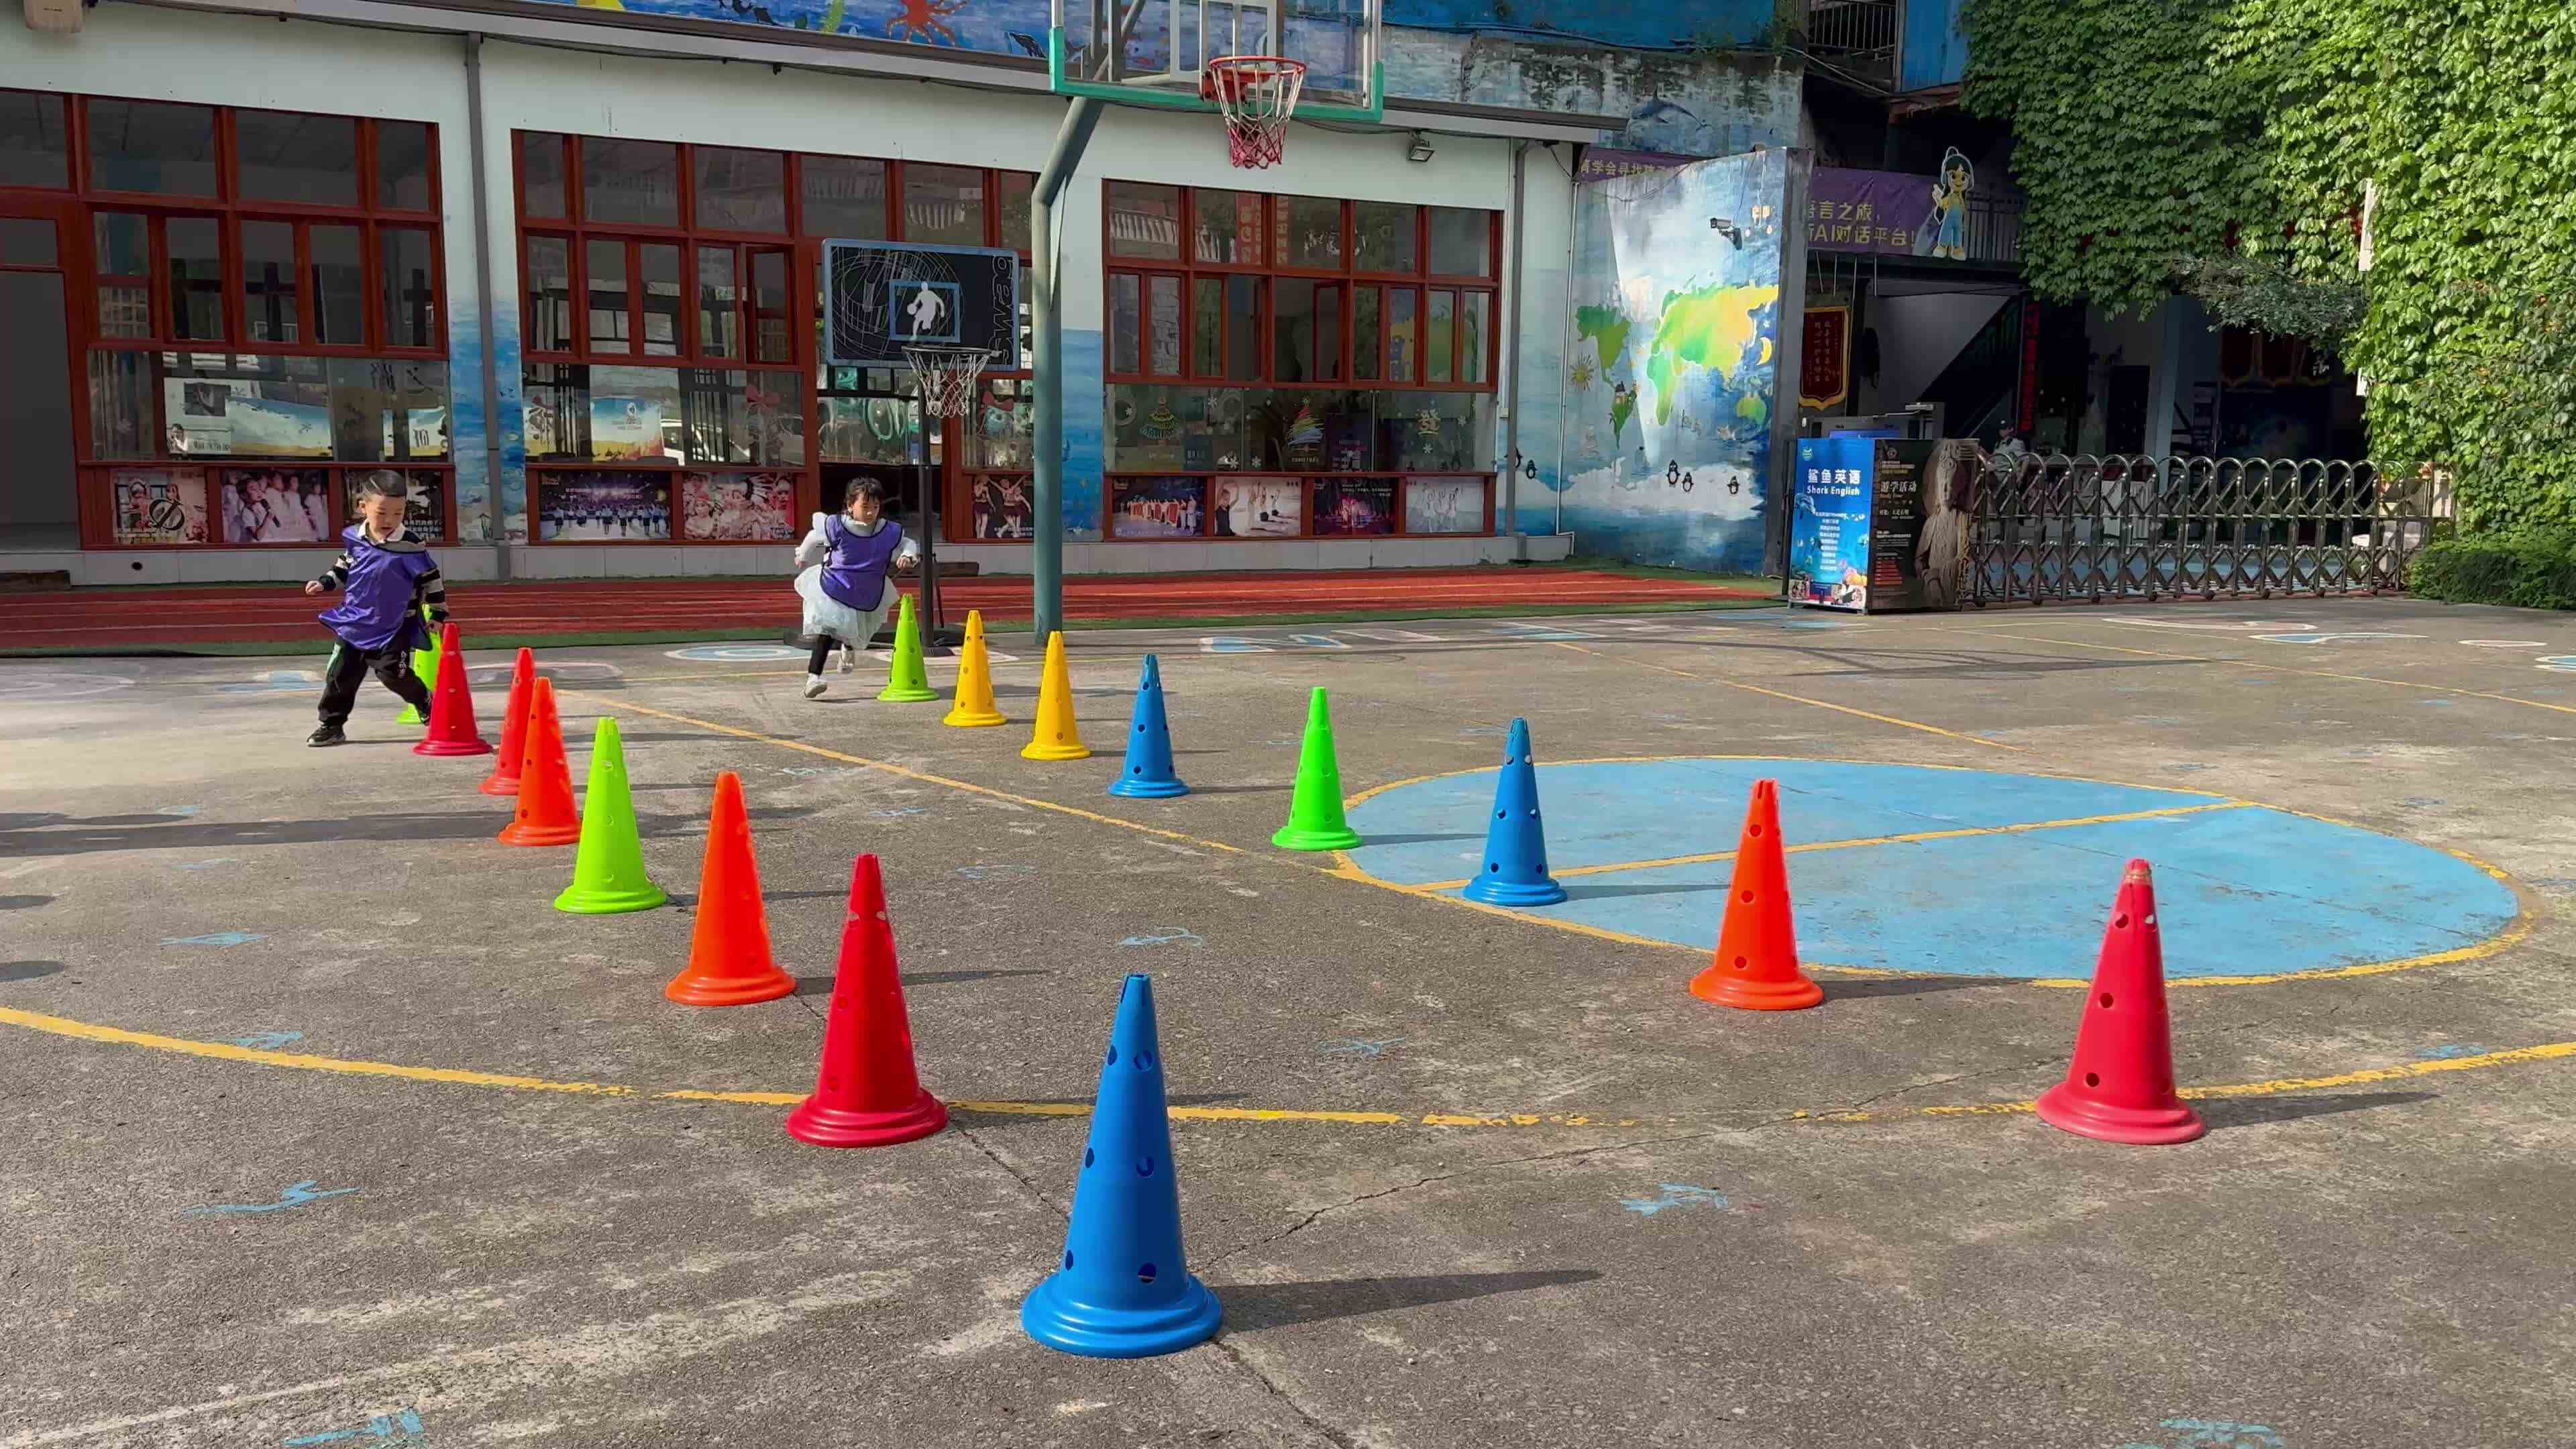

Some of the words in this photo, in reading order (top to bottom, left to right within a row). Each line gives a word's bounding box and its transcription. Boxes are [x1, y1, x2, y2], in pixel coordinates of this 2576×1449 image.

[1808, 468, 1862, 485] 鲨鱼英语
[1807, 485, 1828, 494] Shark
[1831, 486, 1860, 497] English
